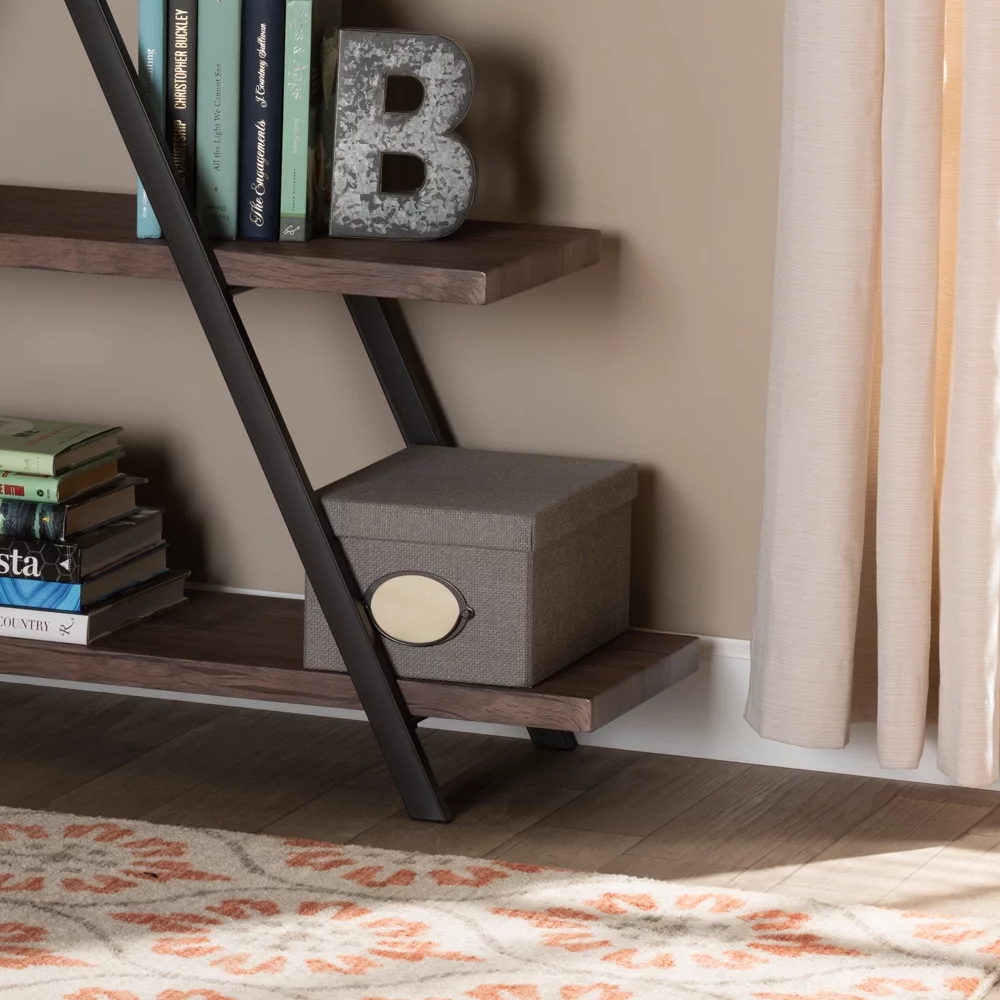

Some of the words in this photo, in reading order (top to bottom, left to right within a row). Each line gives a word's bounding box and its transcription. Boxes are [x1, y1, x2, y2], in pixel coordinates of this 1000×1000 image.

[174, 8, 189, 49] BUCKLEY
[256, 22, 267, 59] Sullivan
[173, 50, 187, 110] CHRISTOPHER
[213, 79, 221, 107] Cannot
[255, 59, 268, 95] Courtney
[213, 109, 221, 122] We
[255, 95, 268, 108] J.
[173, 119, 187, 173] COURTSHIP
[213, 123, 222, 144] Light
[329, 29, 476, 239] B
[212, 146, 220, 159] the
[250, 118, 269, 196] Engagements
[249, 197, 265, 227] The
